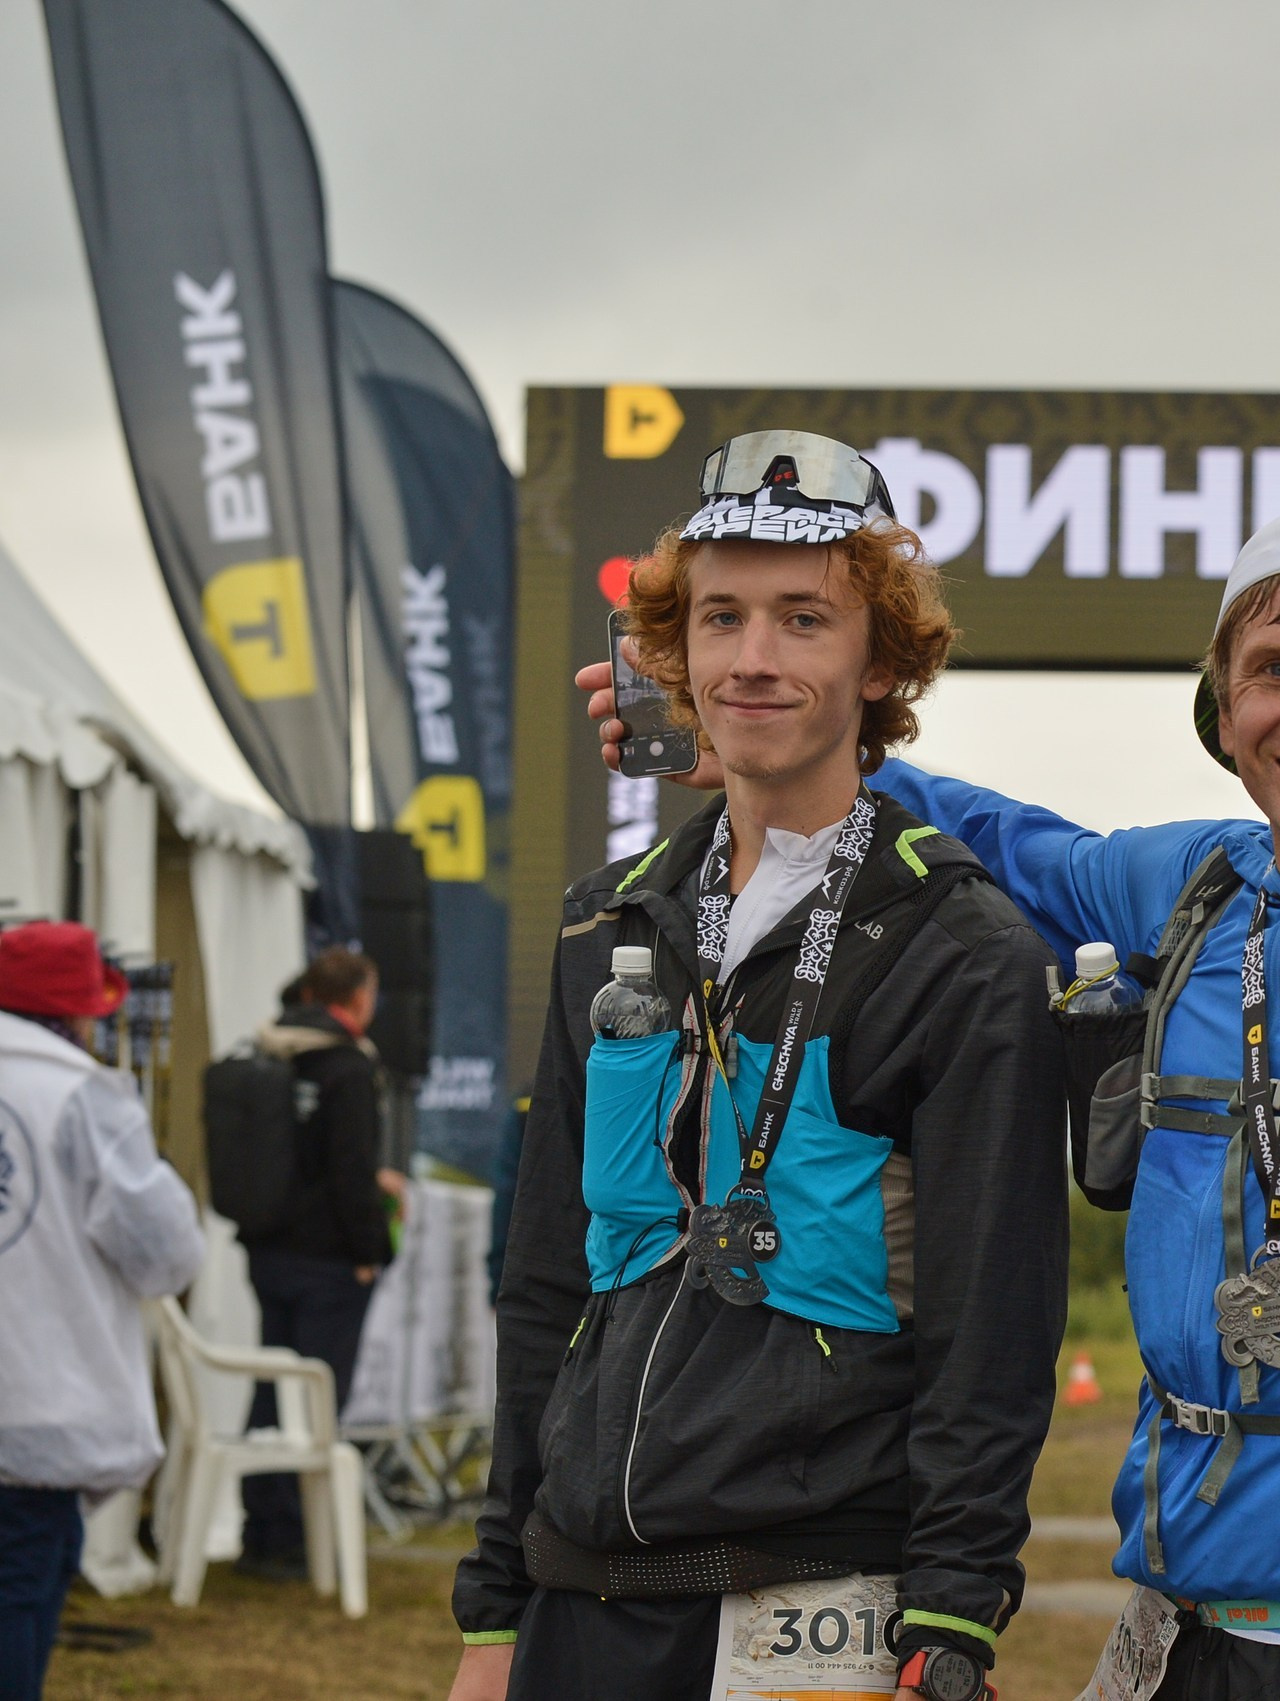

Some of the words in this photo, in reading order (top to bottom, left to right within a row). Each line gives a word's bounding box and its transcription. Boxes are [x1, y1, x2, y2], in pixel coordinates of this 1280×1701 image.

[788, 1007, 798, 1025] WILD
[794, 1007, 804, 1026] TRAIL
[1250, 1047, 1261, 1084] БАНК
[757, 1112, 775, 1149] БАНК
[753, 1231, 776, 1251] 35
[1227, 1605, 1269, 1623] Altai
